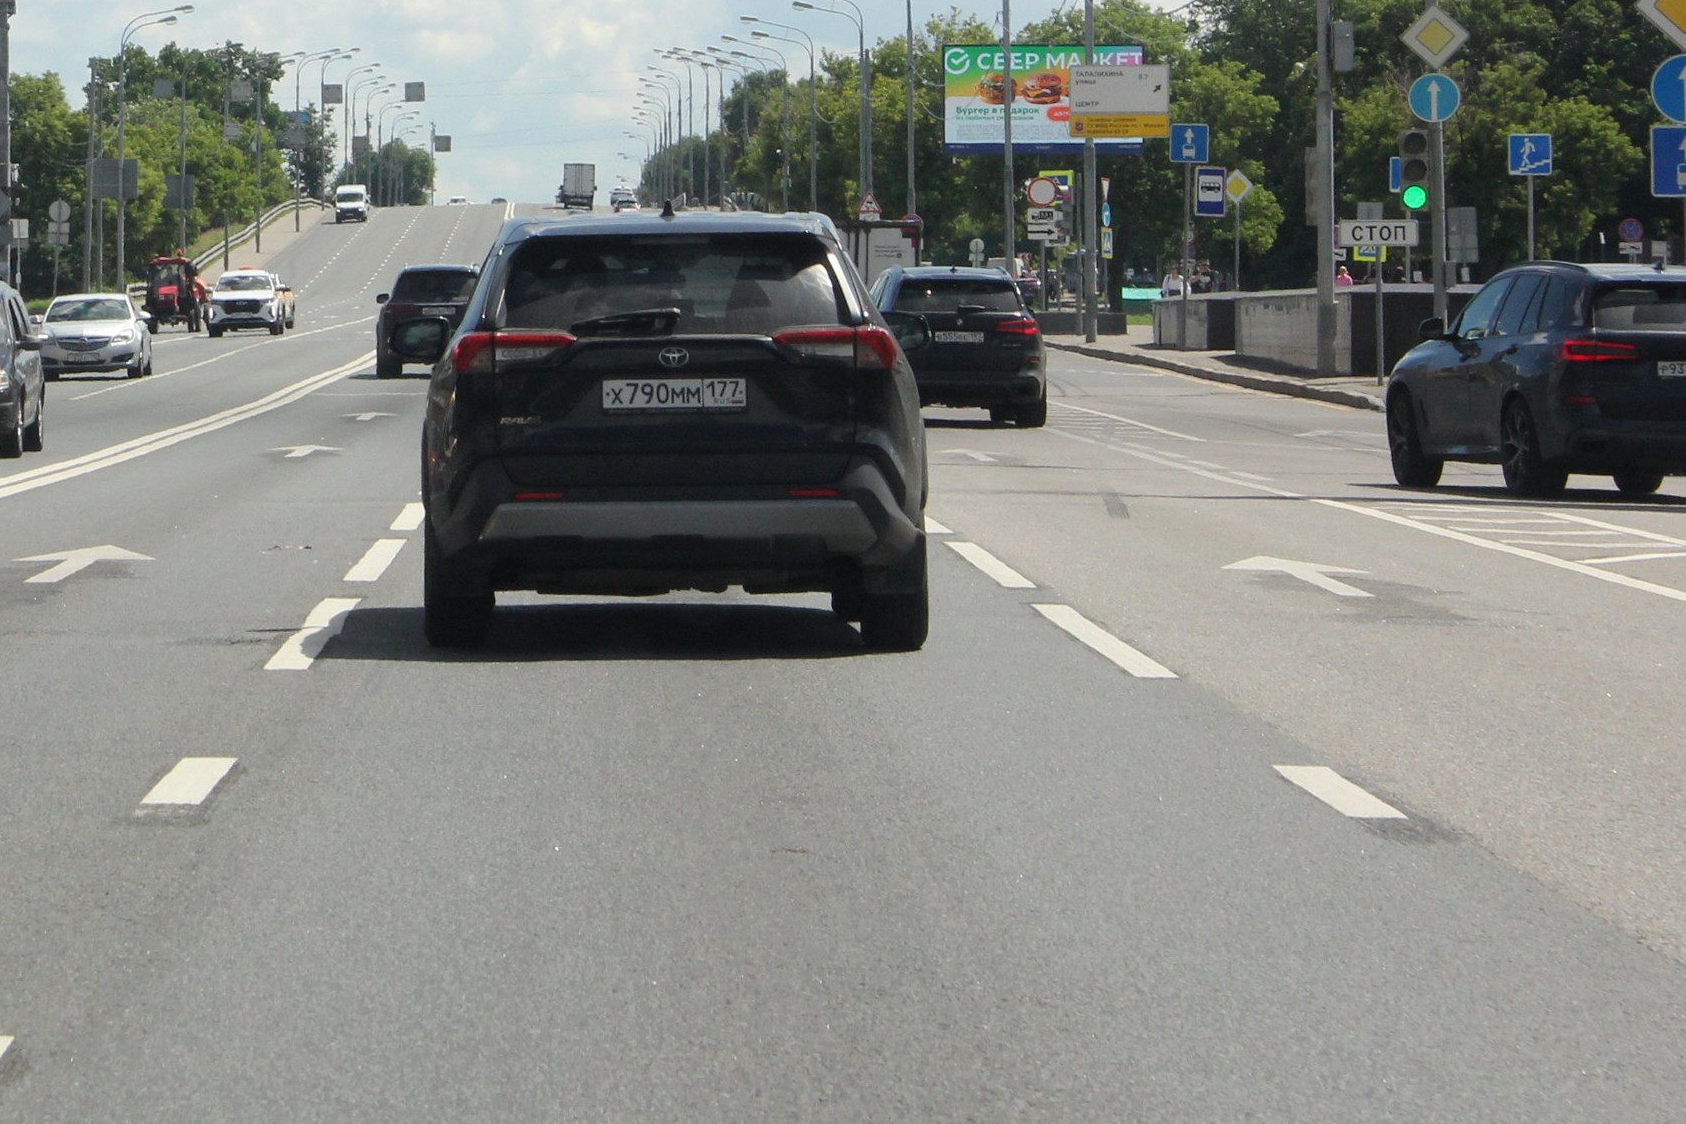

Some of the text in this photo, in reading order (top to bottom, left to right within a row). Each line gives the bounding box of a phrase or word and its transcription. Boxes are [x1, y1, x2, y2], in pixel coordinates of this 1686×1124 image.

[1075, 100, 1100, 108] ЦЕНТР
[955, 106, 990, 115] Бургер
[1000, 107, 1040, 115] пдарок
[1351, 225, 1406, 241] СТОП
[610, 380, 740, 405] Х790ММ 177
